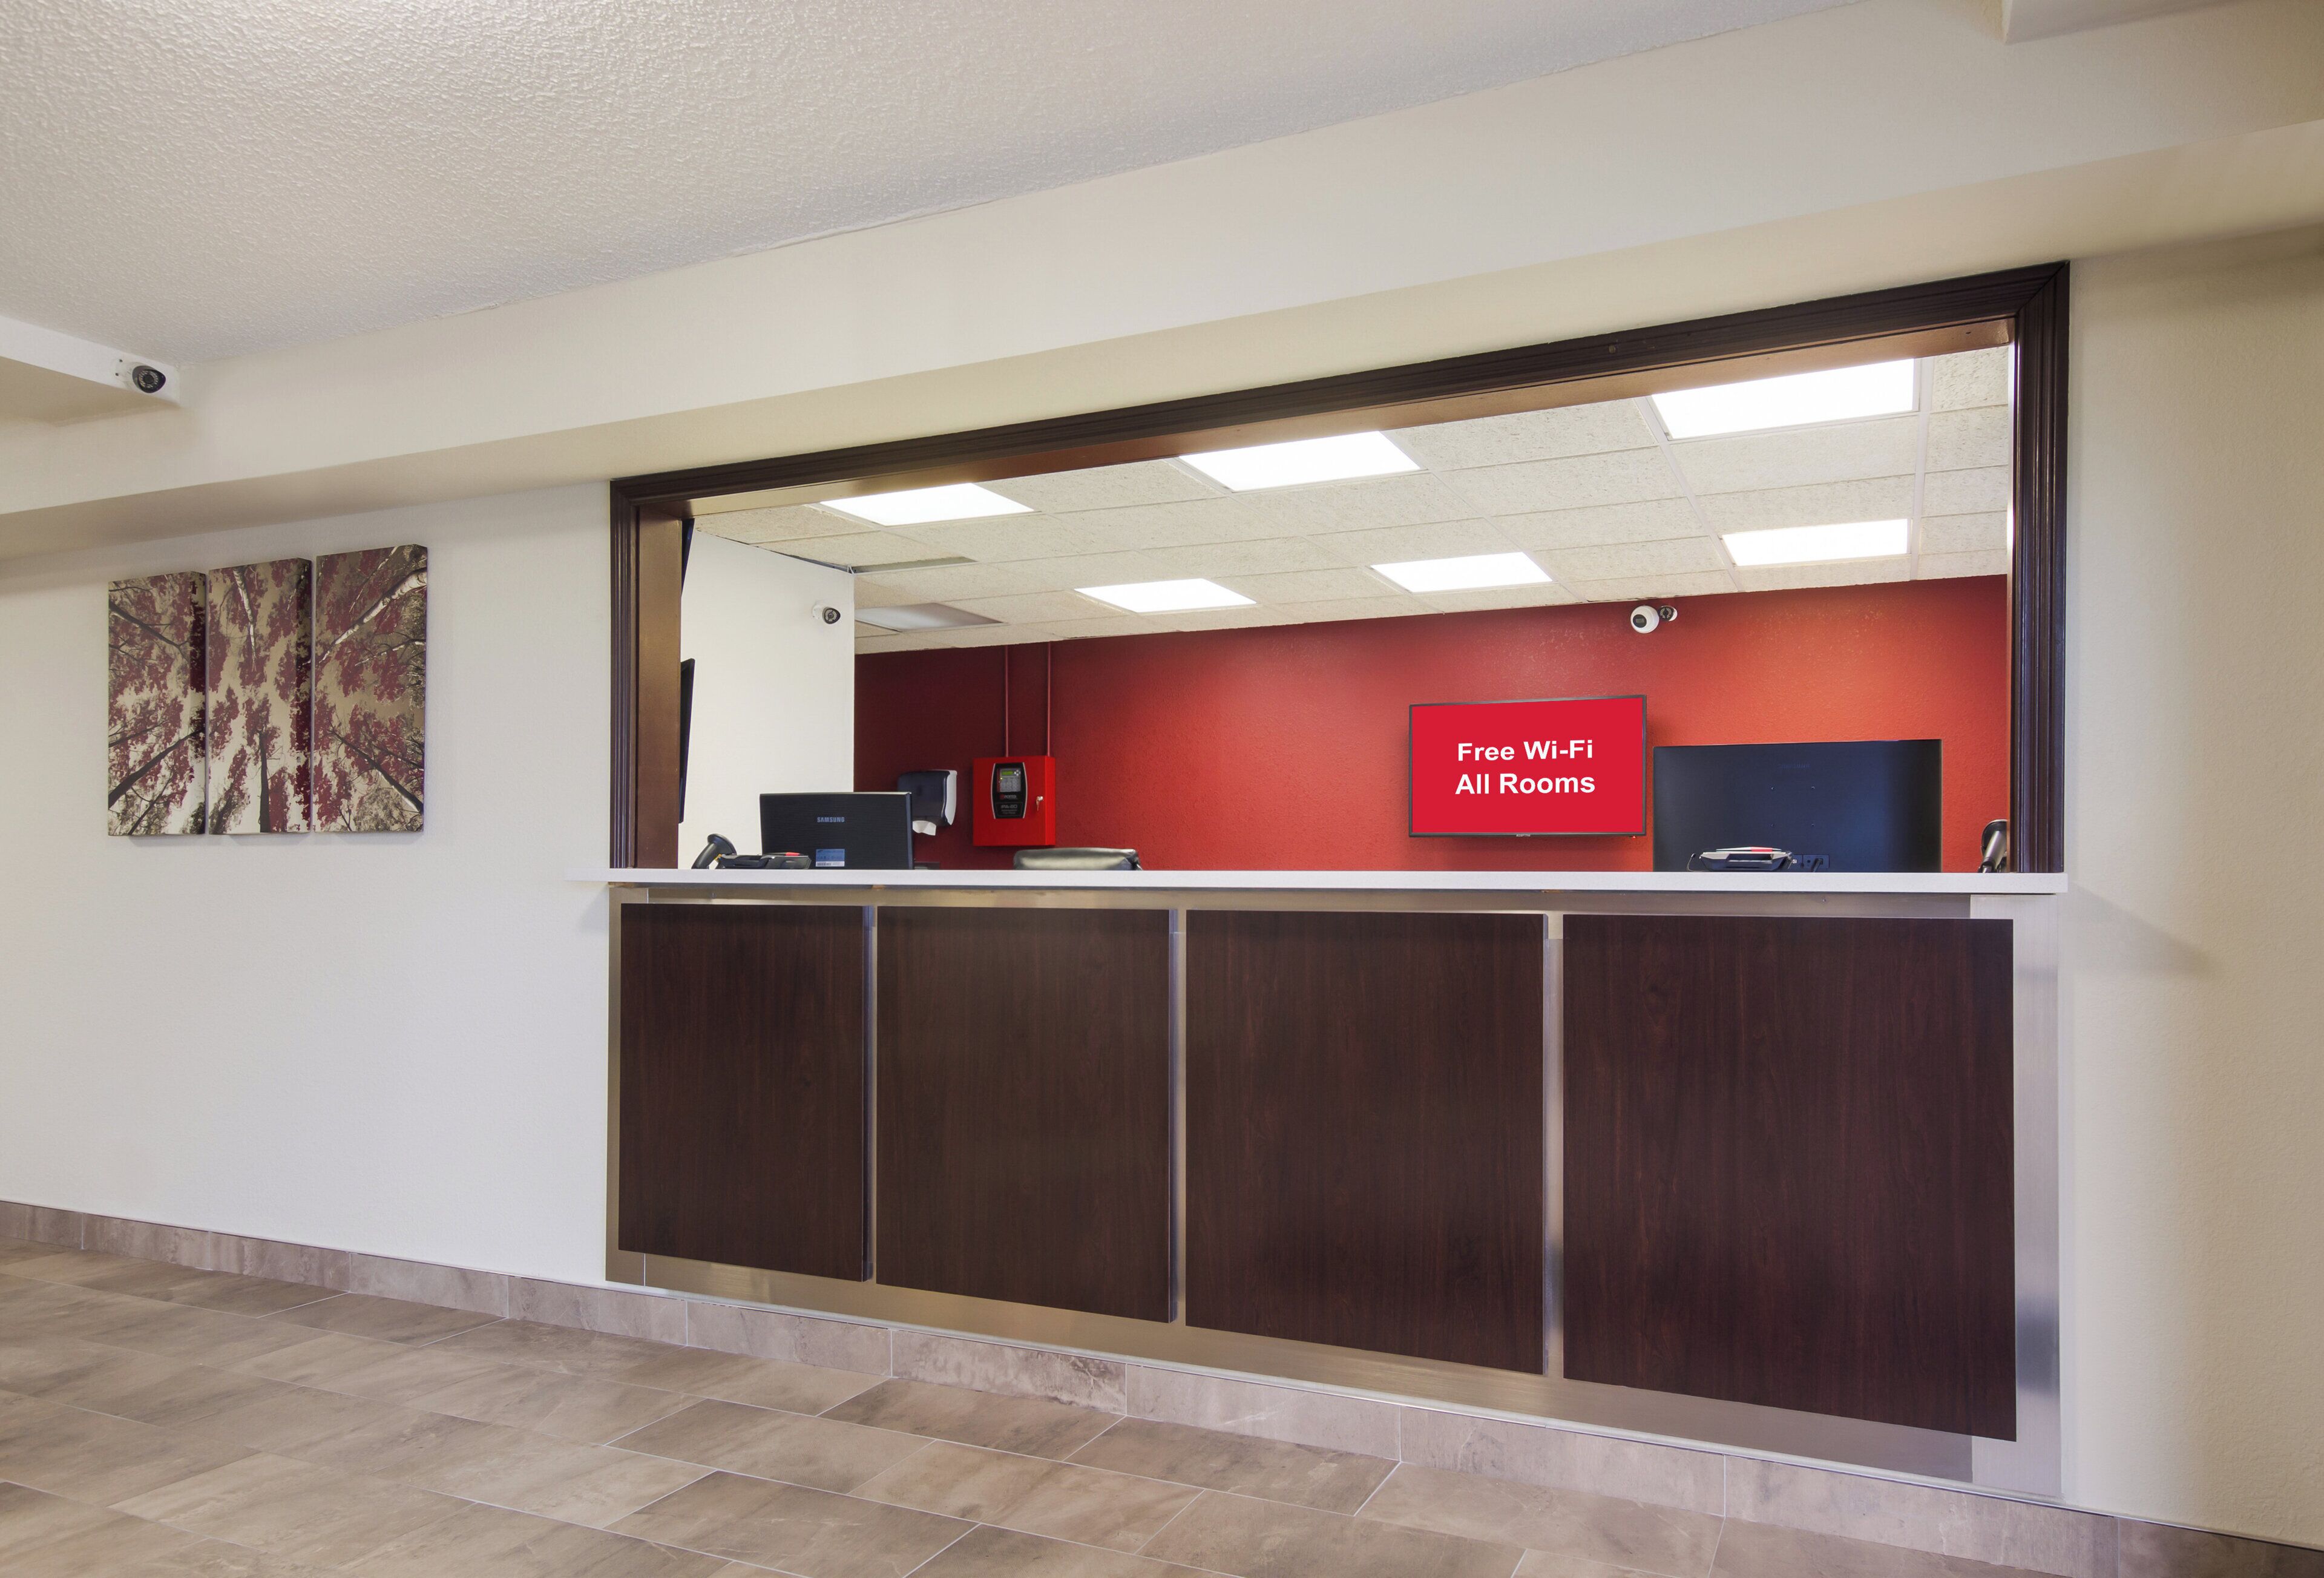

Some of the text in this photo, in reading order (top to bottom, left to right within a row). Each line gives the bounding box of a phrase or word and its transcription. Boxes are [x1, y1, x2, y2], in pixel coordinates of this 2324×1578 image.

[1458, 739, 1593, 761] Free Wi-Fi
[1455, 773, 1595, 795] All Rooms
